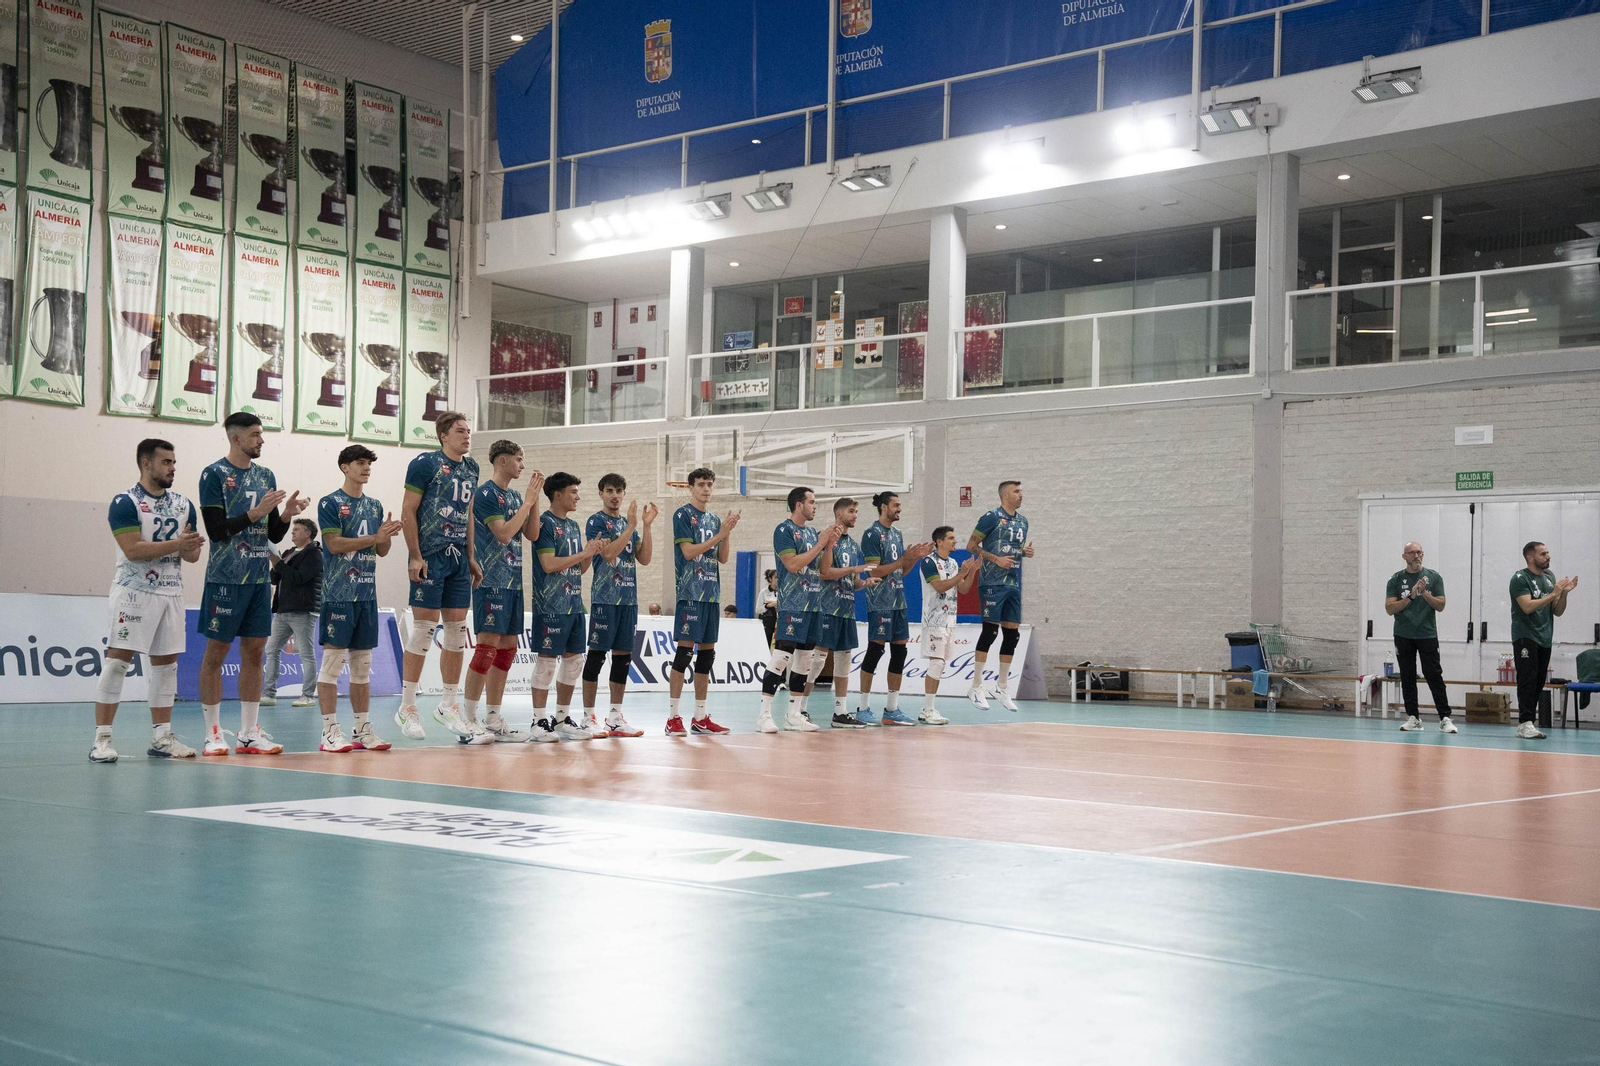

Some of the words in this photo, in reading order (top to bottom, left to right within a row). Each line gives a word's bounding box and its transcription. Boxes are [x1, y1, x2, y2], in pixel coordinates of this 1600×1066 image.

[37, 0, 83, 20] ALMERÍA
[1062, 0, 1116, 14] DIPUTA
[1064, 14, 1077, 26] DE
[1079, 2, 1125, 22] ALMERÍA
[33, 17, 88, 40] CAMPEÓN
[112, 20, 150, 36] UNICAJA
[109, 31, 153, 47] ALMERÍA
[178, 33, 215, 50] UNICAJA
[106, 46, 158, 67] CAMPEÓN
[176, 42, 217, 62] ALMERÍA
[836, 45, 884, 64] IPUTACIÓN
[172, 57, 220, 80] CAMPEÓN
[246, 53, 280, 69] UNICAJA
[844, 57, 883, 74] ALMERÍA
[244, 63, 282, 80] ALMERÍA
[305, 70, 337, 85] UNICAJA
[303, 80, 339, 96] ALMERÍA
[363, 90, 393, 104] UNICAJA
[636, 90, 681, 108] DIPUTACIÓN
[362, 99, 395, 114] ALMERÍA
[413, 103, 442, 117] UNICAJA
[637, 108, 648, 118] DE
[649, 101, 680, 116] ALMERÍA
[411, 112, 443, 127] ALMERÍA
[57, 178, 80, 190] Unicaja
[38, 198, 80, 216] UNICAJA
[136, 204, 157, 214] Unicaja
[35, 210, 81, 228] ALMERÍA
[193, 211, 214, 222] Unicaja
[32, 226, 84, 248] CAMPEÓN
[119, 223, 156, 236] UNICAJA
[260, 225, 278, 235] Unicaja
[117, 233, 160, 247] ALMERÍA
[176, 230, 213, 246] UNICAJA
[320, 236, 338, 245] Unicaja
[40, 246, 53, 256] Copa
[54, 249, 63, 257] del
[64, 251, 74, 260] Rey
[174, 241, 214, 256] ALMERÍA
[244, 242, 277, 256] UNICAJA
[378, 250, 395, 260] Unicaja
[169, 257, 218, 276] CAMPEÓN
[241, 252, 279, 267] ALMERÍA
[306, 255, 338, 267] UNICAJA
[426, 260, 442, 268] Unicaja
[304, 265, 340, 278] ALMERÍA
[364, 268, 394, 280] UNICAJA
[362, 278, 396, 291] ALMERÍA
[413, 278, 442, 290] UNICAJA
[411, 287, 444, 299] ALMERÍA
[48, 387, 71, 397] Unicaja
[187, 406, 206, 415] Unicaja
[320, 420, 338, 428] Unicaja
[375, 428, 392, 436] Unicaja
[1459, 473, 1481, 481] SALIDA
[1482, 472, 1491, 480] DE
[452, 478, 472, 503] 16
[1457, 481, 1492, 490] EMERGENCIA
[246, 491, 257, 510] 7
[152, 517, 179, 542] 22
[357, 520, 368, 538] 4
[1008, 527, 1024, 542] 14
[567, 539, 578, 555] 11
[891, 543, 898, 560] 8
[842, 552, 850, 567] 9
[662, 661, 768, 684] COLADO
[245, 807, 566, 848] Fundación
[390, 810, 628, 841] Unicaja
